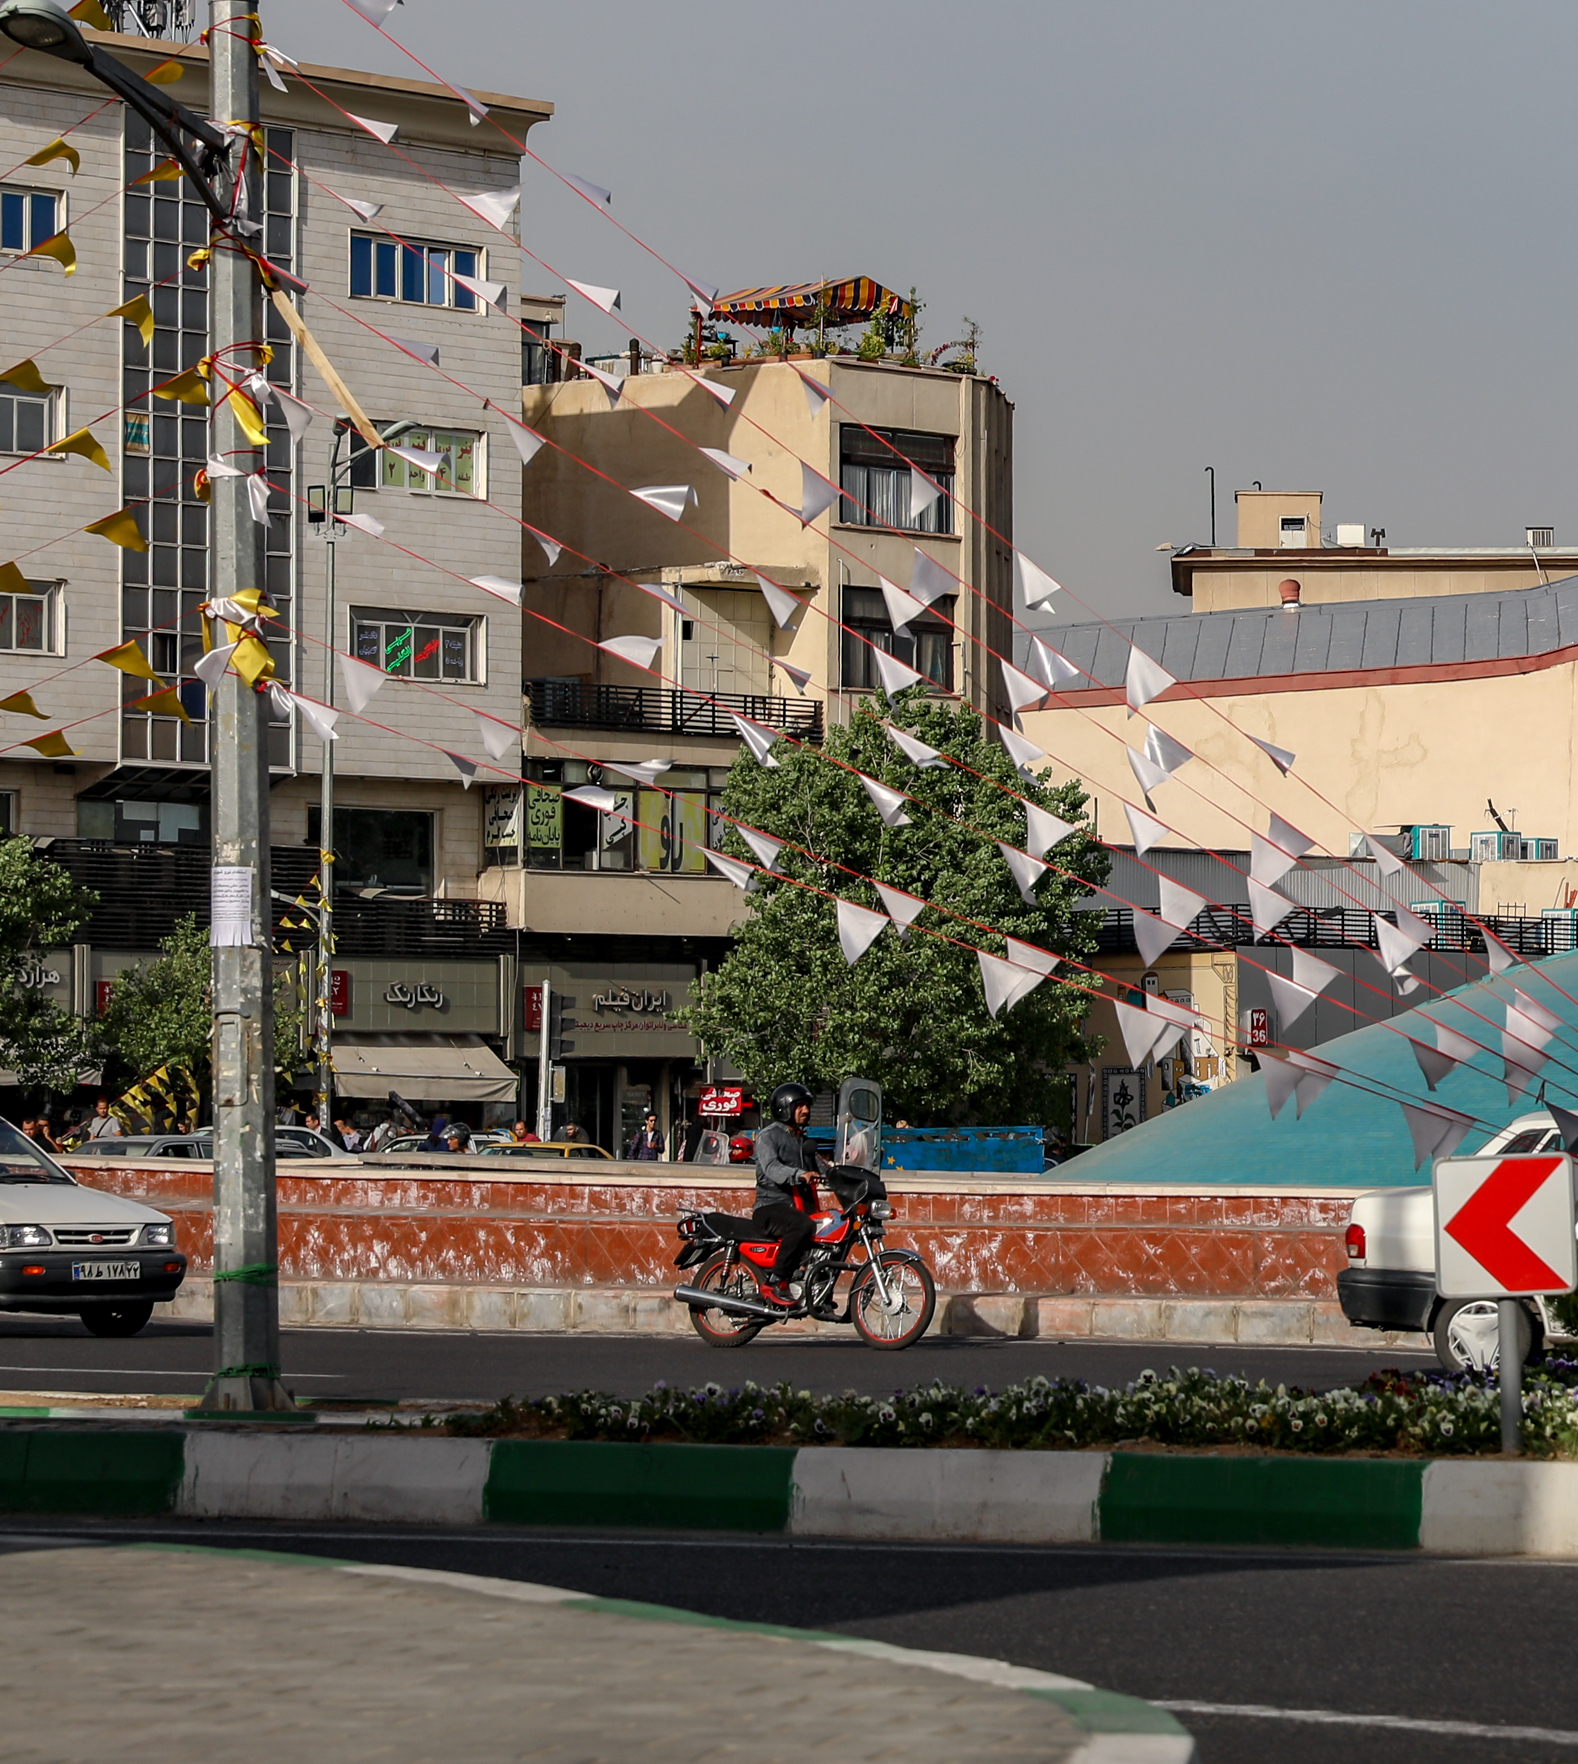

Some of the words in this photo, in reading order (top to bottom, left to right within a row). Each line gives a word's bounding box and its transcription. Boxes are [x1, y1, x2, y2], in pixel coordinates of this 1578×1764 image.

[388, 462, 396, 478] ۲
[528, 785, 560, 810] صحافی
[531, 806, 556, 827] فوری
[592, 986, 630, 1012] فیلم
[631, 989, 667, 1012] ایران
[1252, 1030, 1266, 1042] 36
[701, 1088, 741, 1101] صحافی
[702, 1098, 738, 1112] فوری
